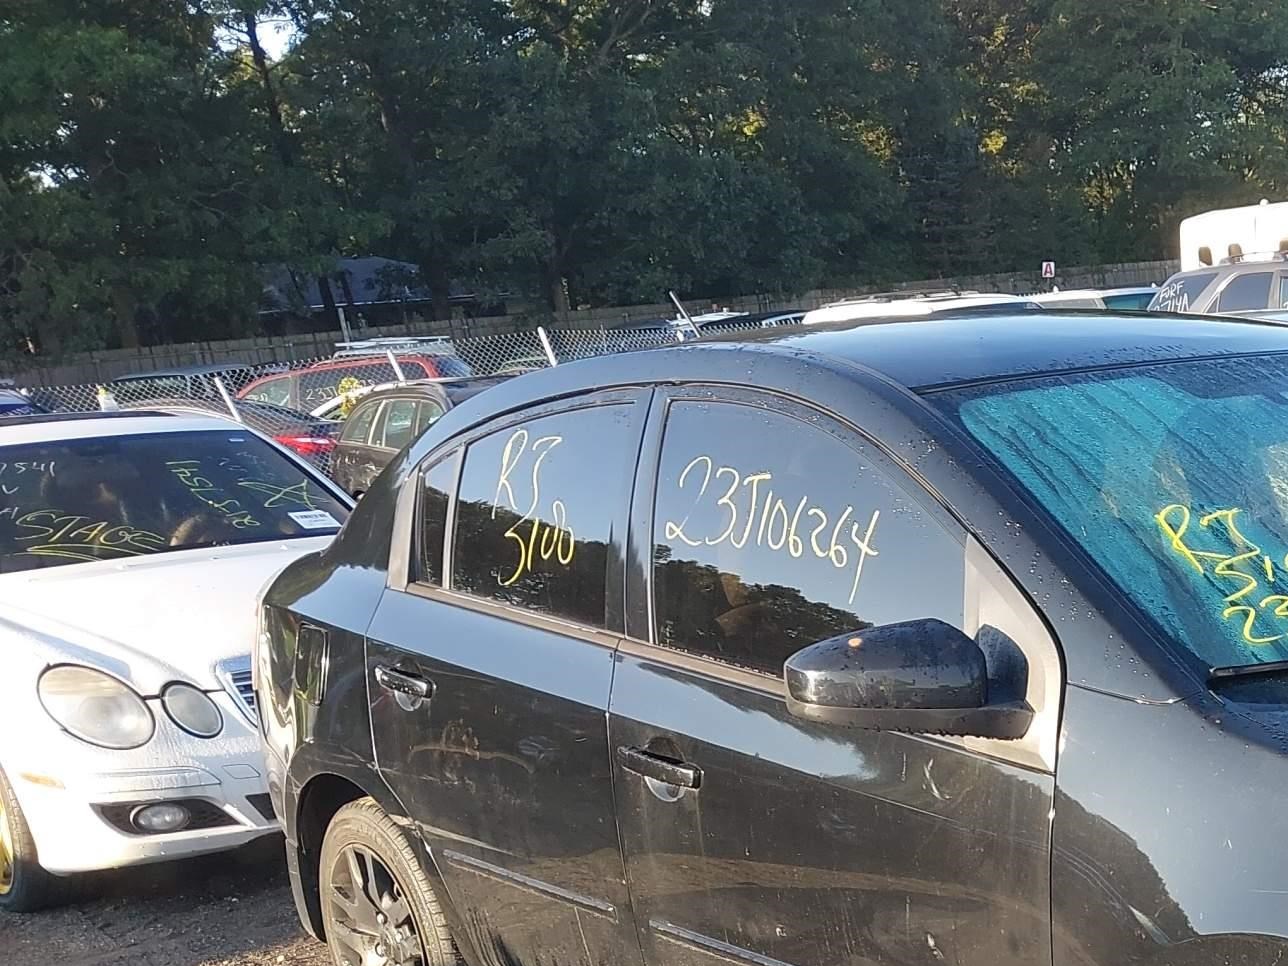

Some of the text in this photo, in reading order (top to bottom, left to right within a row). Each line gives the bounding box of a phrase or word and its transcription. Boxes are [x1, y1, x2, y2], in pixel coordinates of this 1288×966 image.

[1043, 263, 1053, 276] A
[14, 509, 166, 552] STAGE
[665, 456, 881, 605] 23J106264
